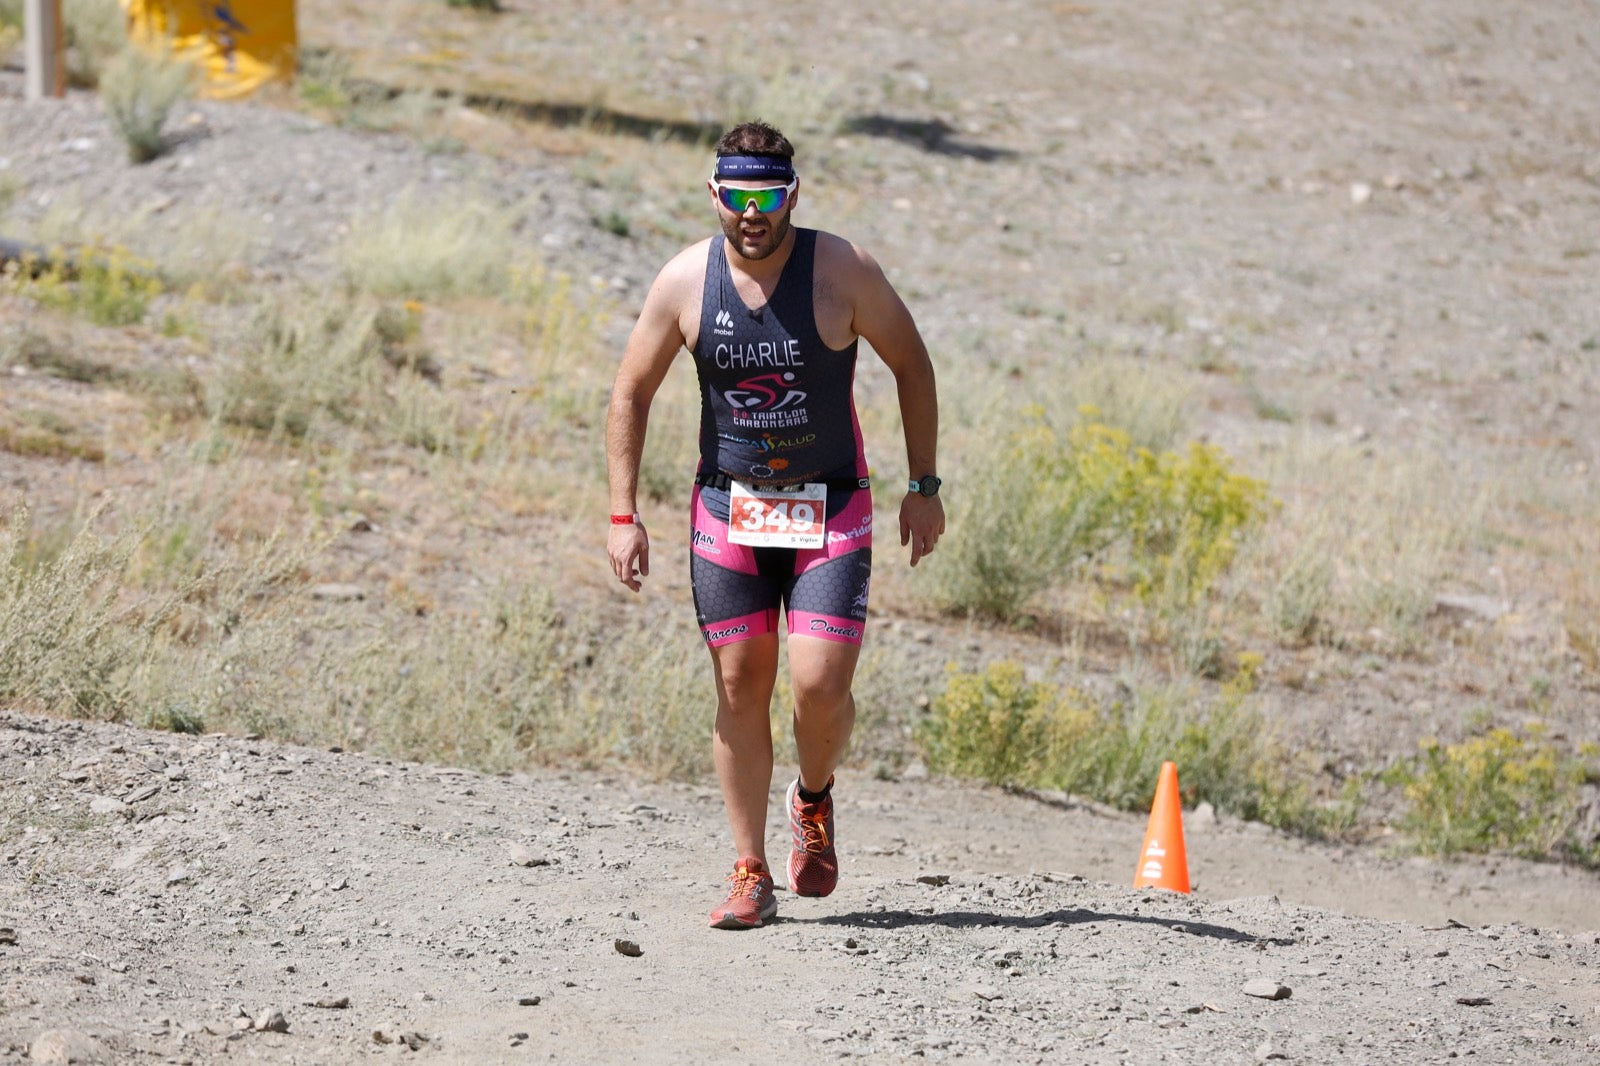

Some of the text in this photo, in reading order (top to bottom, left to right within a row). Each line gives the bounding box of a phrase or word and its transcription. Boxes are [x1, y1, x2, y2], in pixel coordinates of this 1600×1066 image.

[713, 328, 734, 336] mobel
[715, 339, 804, 369] CHARLIE
[752, 408, 807, 420] TRIATLON
[733, 416, 809, 429] CARBONERAS
[741, 501, 814, 532] 349
[810, 619, 859, 638] Donde
